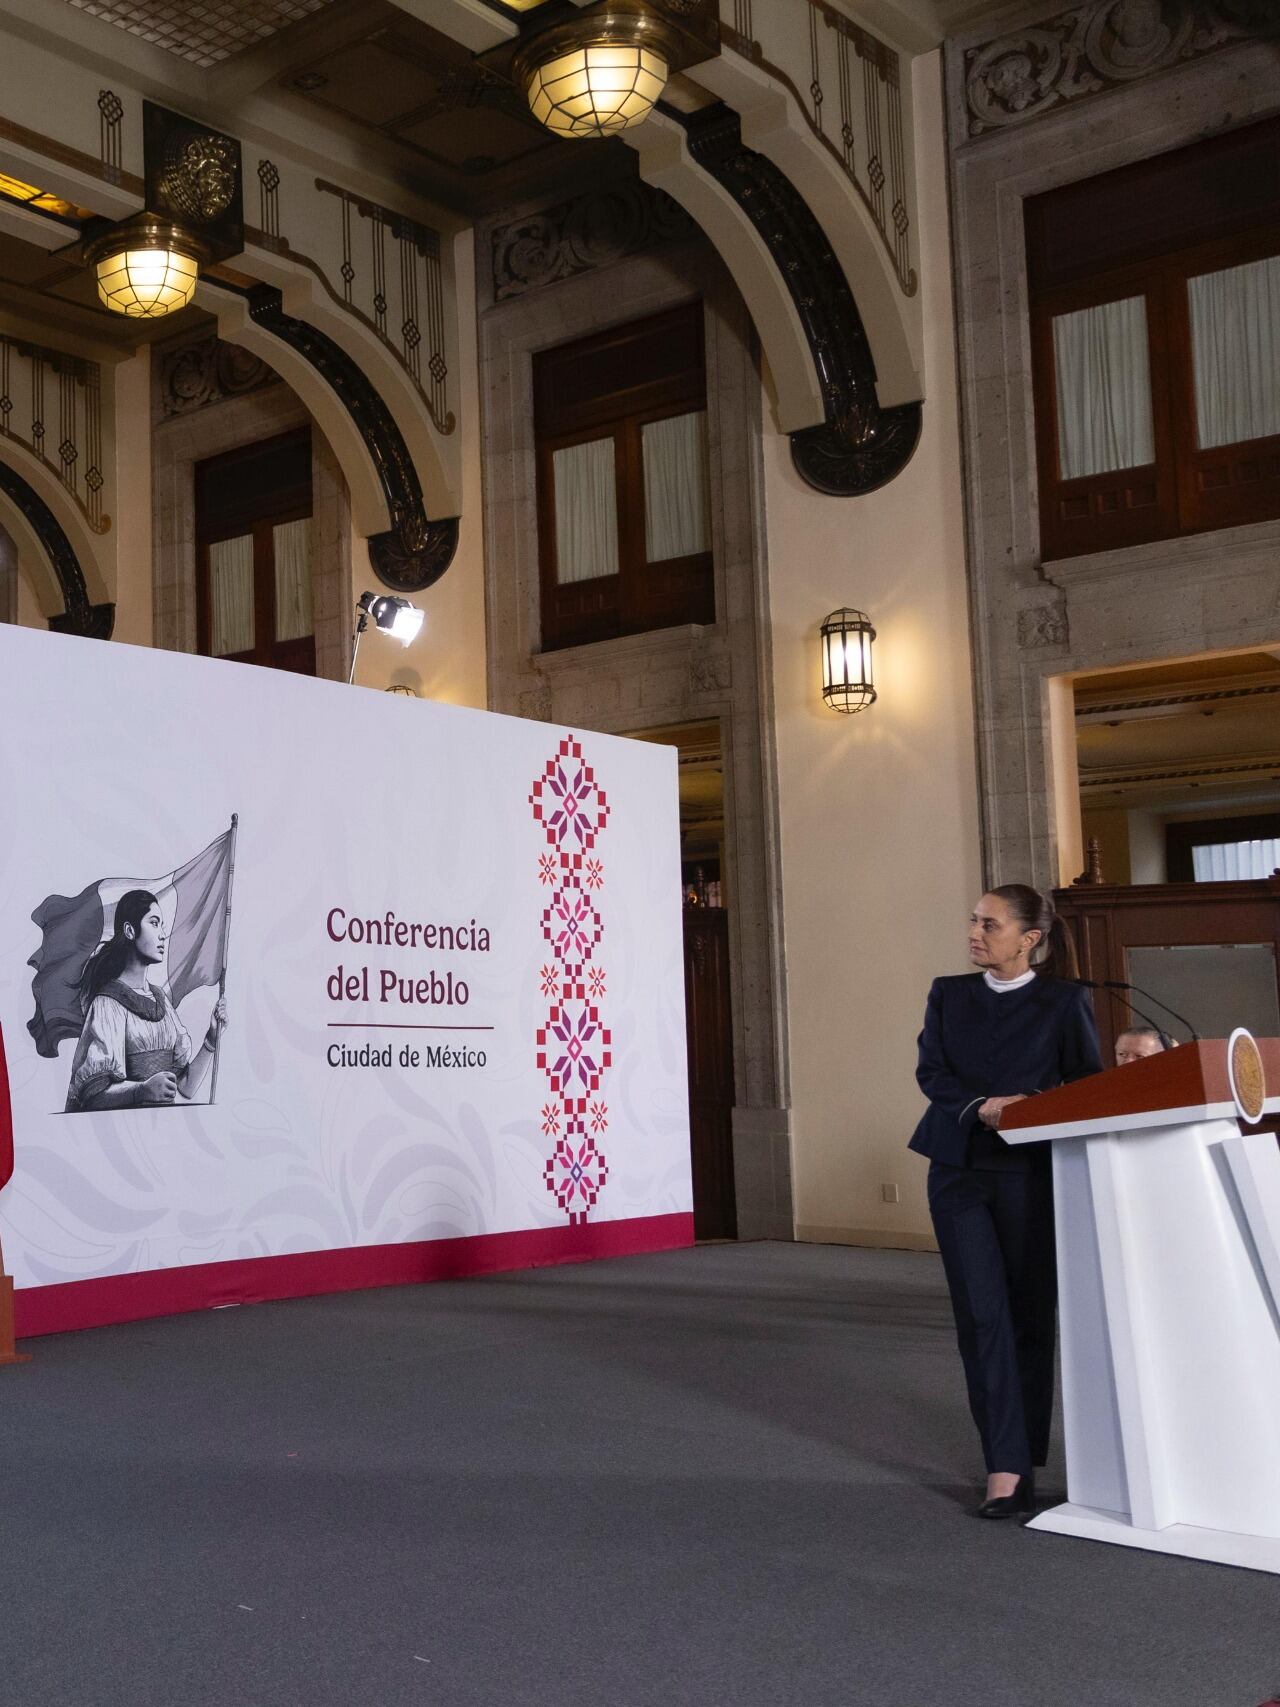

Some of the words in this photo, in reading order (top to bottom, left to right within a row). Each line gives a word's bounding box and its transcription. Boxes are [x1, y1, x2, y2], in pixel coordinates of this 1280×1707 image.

[327, 907, 490, 951] Conferencia
[327, 965, 369, 1001] del
[380, 970, 469, 1005] Pueblo
[327, 1043, 392, 1067] Ciudad
[399, 1044, 420, 1067] de
[426, 1045, 487, 1067] México
